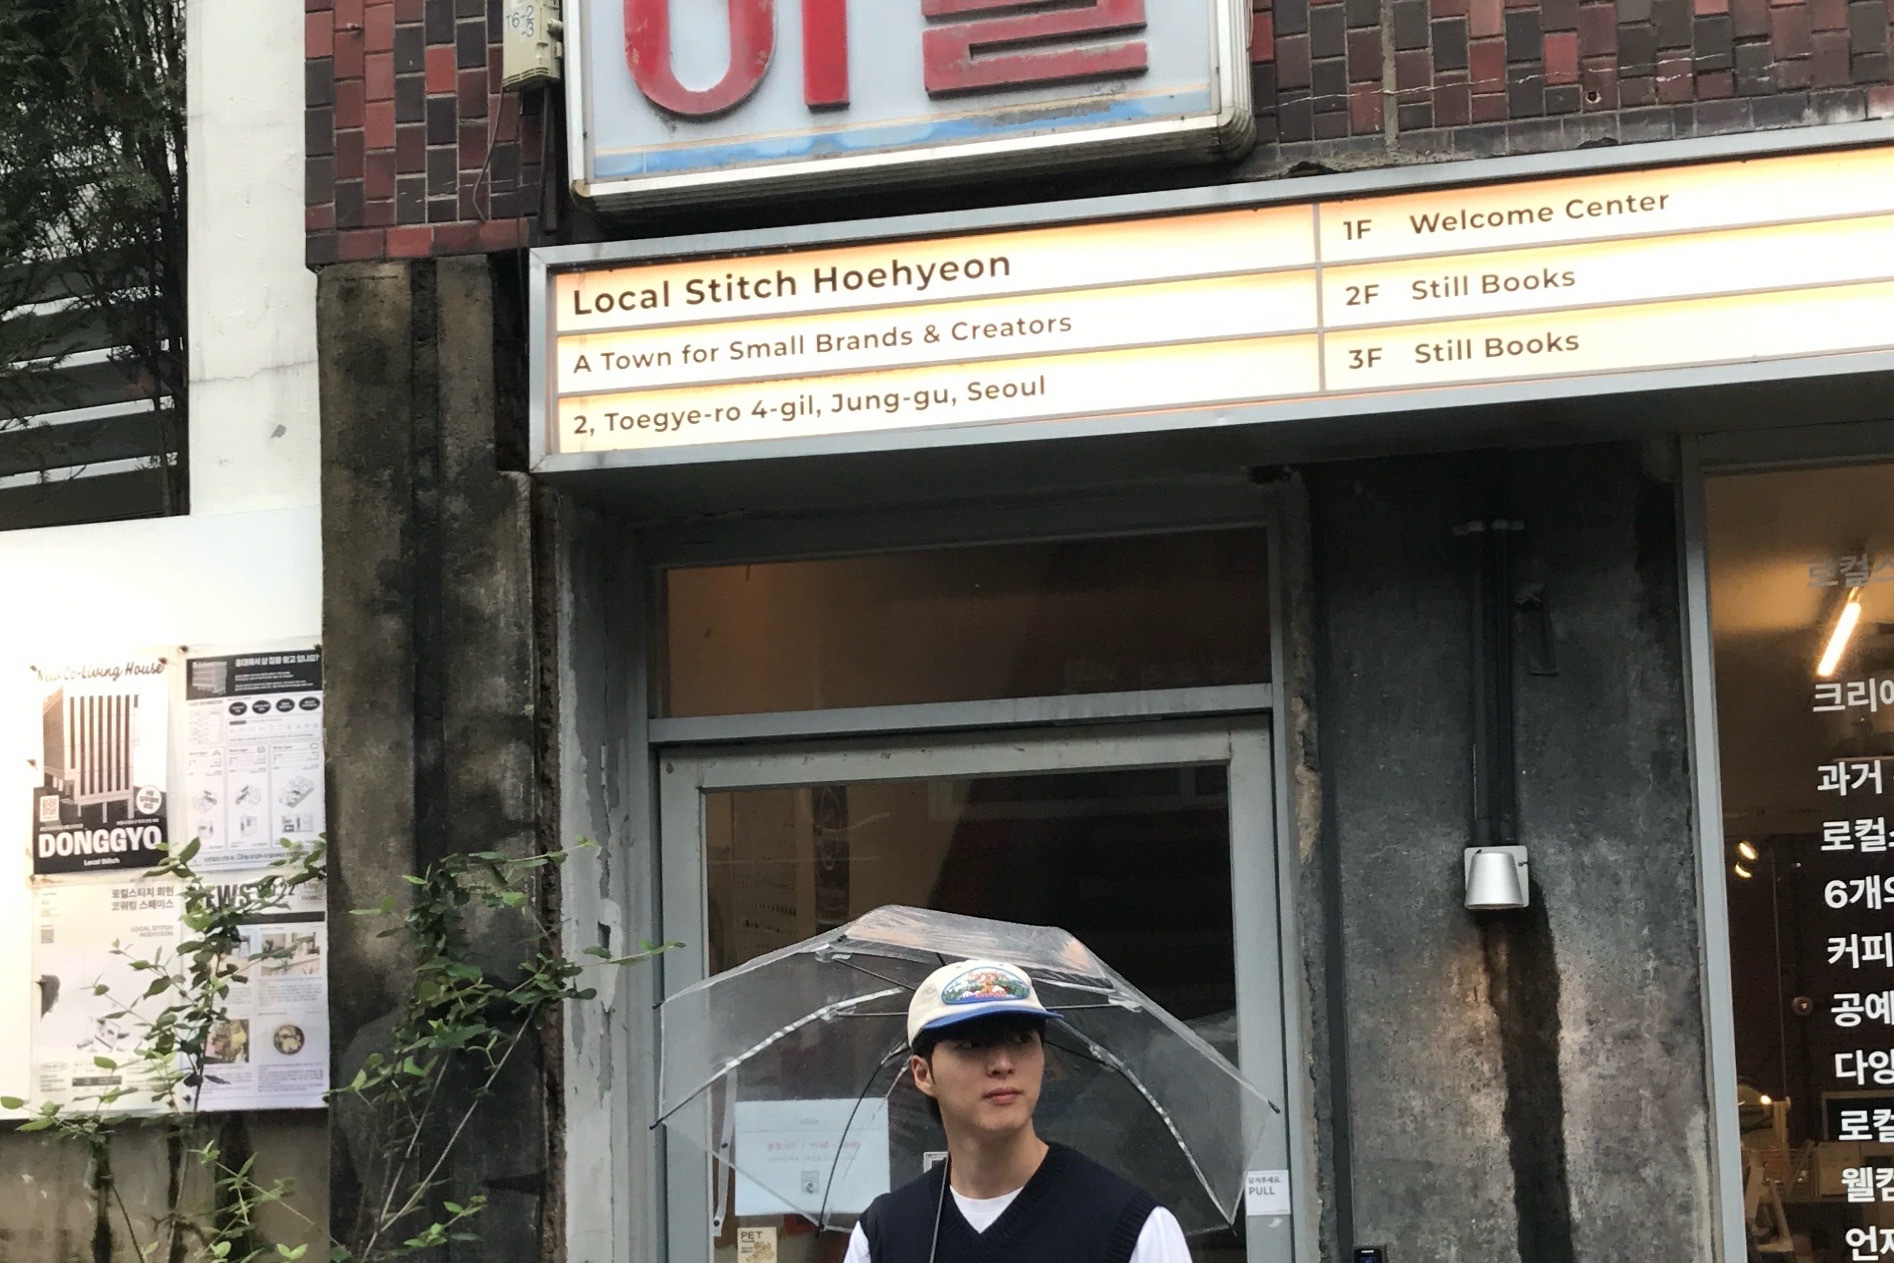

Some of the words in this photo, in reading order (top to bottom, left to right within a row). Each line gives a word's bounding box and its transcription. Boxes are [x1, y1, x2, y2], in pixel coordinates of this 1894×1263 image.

[1343, 218, 1372, 241] 1F
[1410, 206, 1554, 235] Welcome
[1565, 193, 1669, 220] Center
[573, 280, 670, 316] Local
[685, 270, 797, 305] Stitch
[813, 255, 1011, 294] Hoehyeon
[1345, 284, 1379, 306] 2F
[1411, 275, 1469, 300] Still
[1481, 268, 1576, 294] Books
[573, 354, 592, 374] A
[600, 350, 672, 371] Town
[682, 344, 719, 364] for
[729, 335, 805, 360] Small
[815, 326, 912, 353] Brands
[923, 324, 940, 344] &
[951, 316, 1072, 341] Creators
[1348, 347, 1383, 370] 3F
[1414, 338, 1472, 364] Still
[1485, 332, 1580, 358] Books
[573, 415, 595, 436] 2,
[604, 405, 741, 432] Toegye-ro
[751, 394, 822, 422] 4-gil,
[831, 388, 957, 414] Jung-gu,
[967, 375, 1045, 401] Seoul
[124, 660, 164, 676] House
[1817, 759, 1883, 797] 과거
[38, 826, 162, 858] DONGGYO
[1820, 817, 1894, 853] 로컬
[139, 899, 174, 911] 스페이스
[1827, 932, 1894, 969] 커피
[1248, 1185, 1276, 1196] PULL
[740, 1231, 763, 1240] PET
